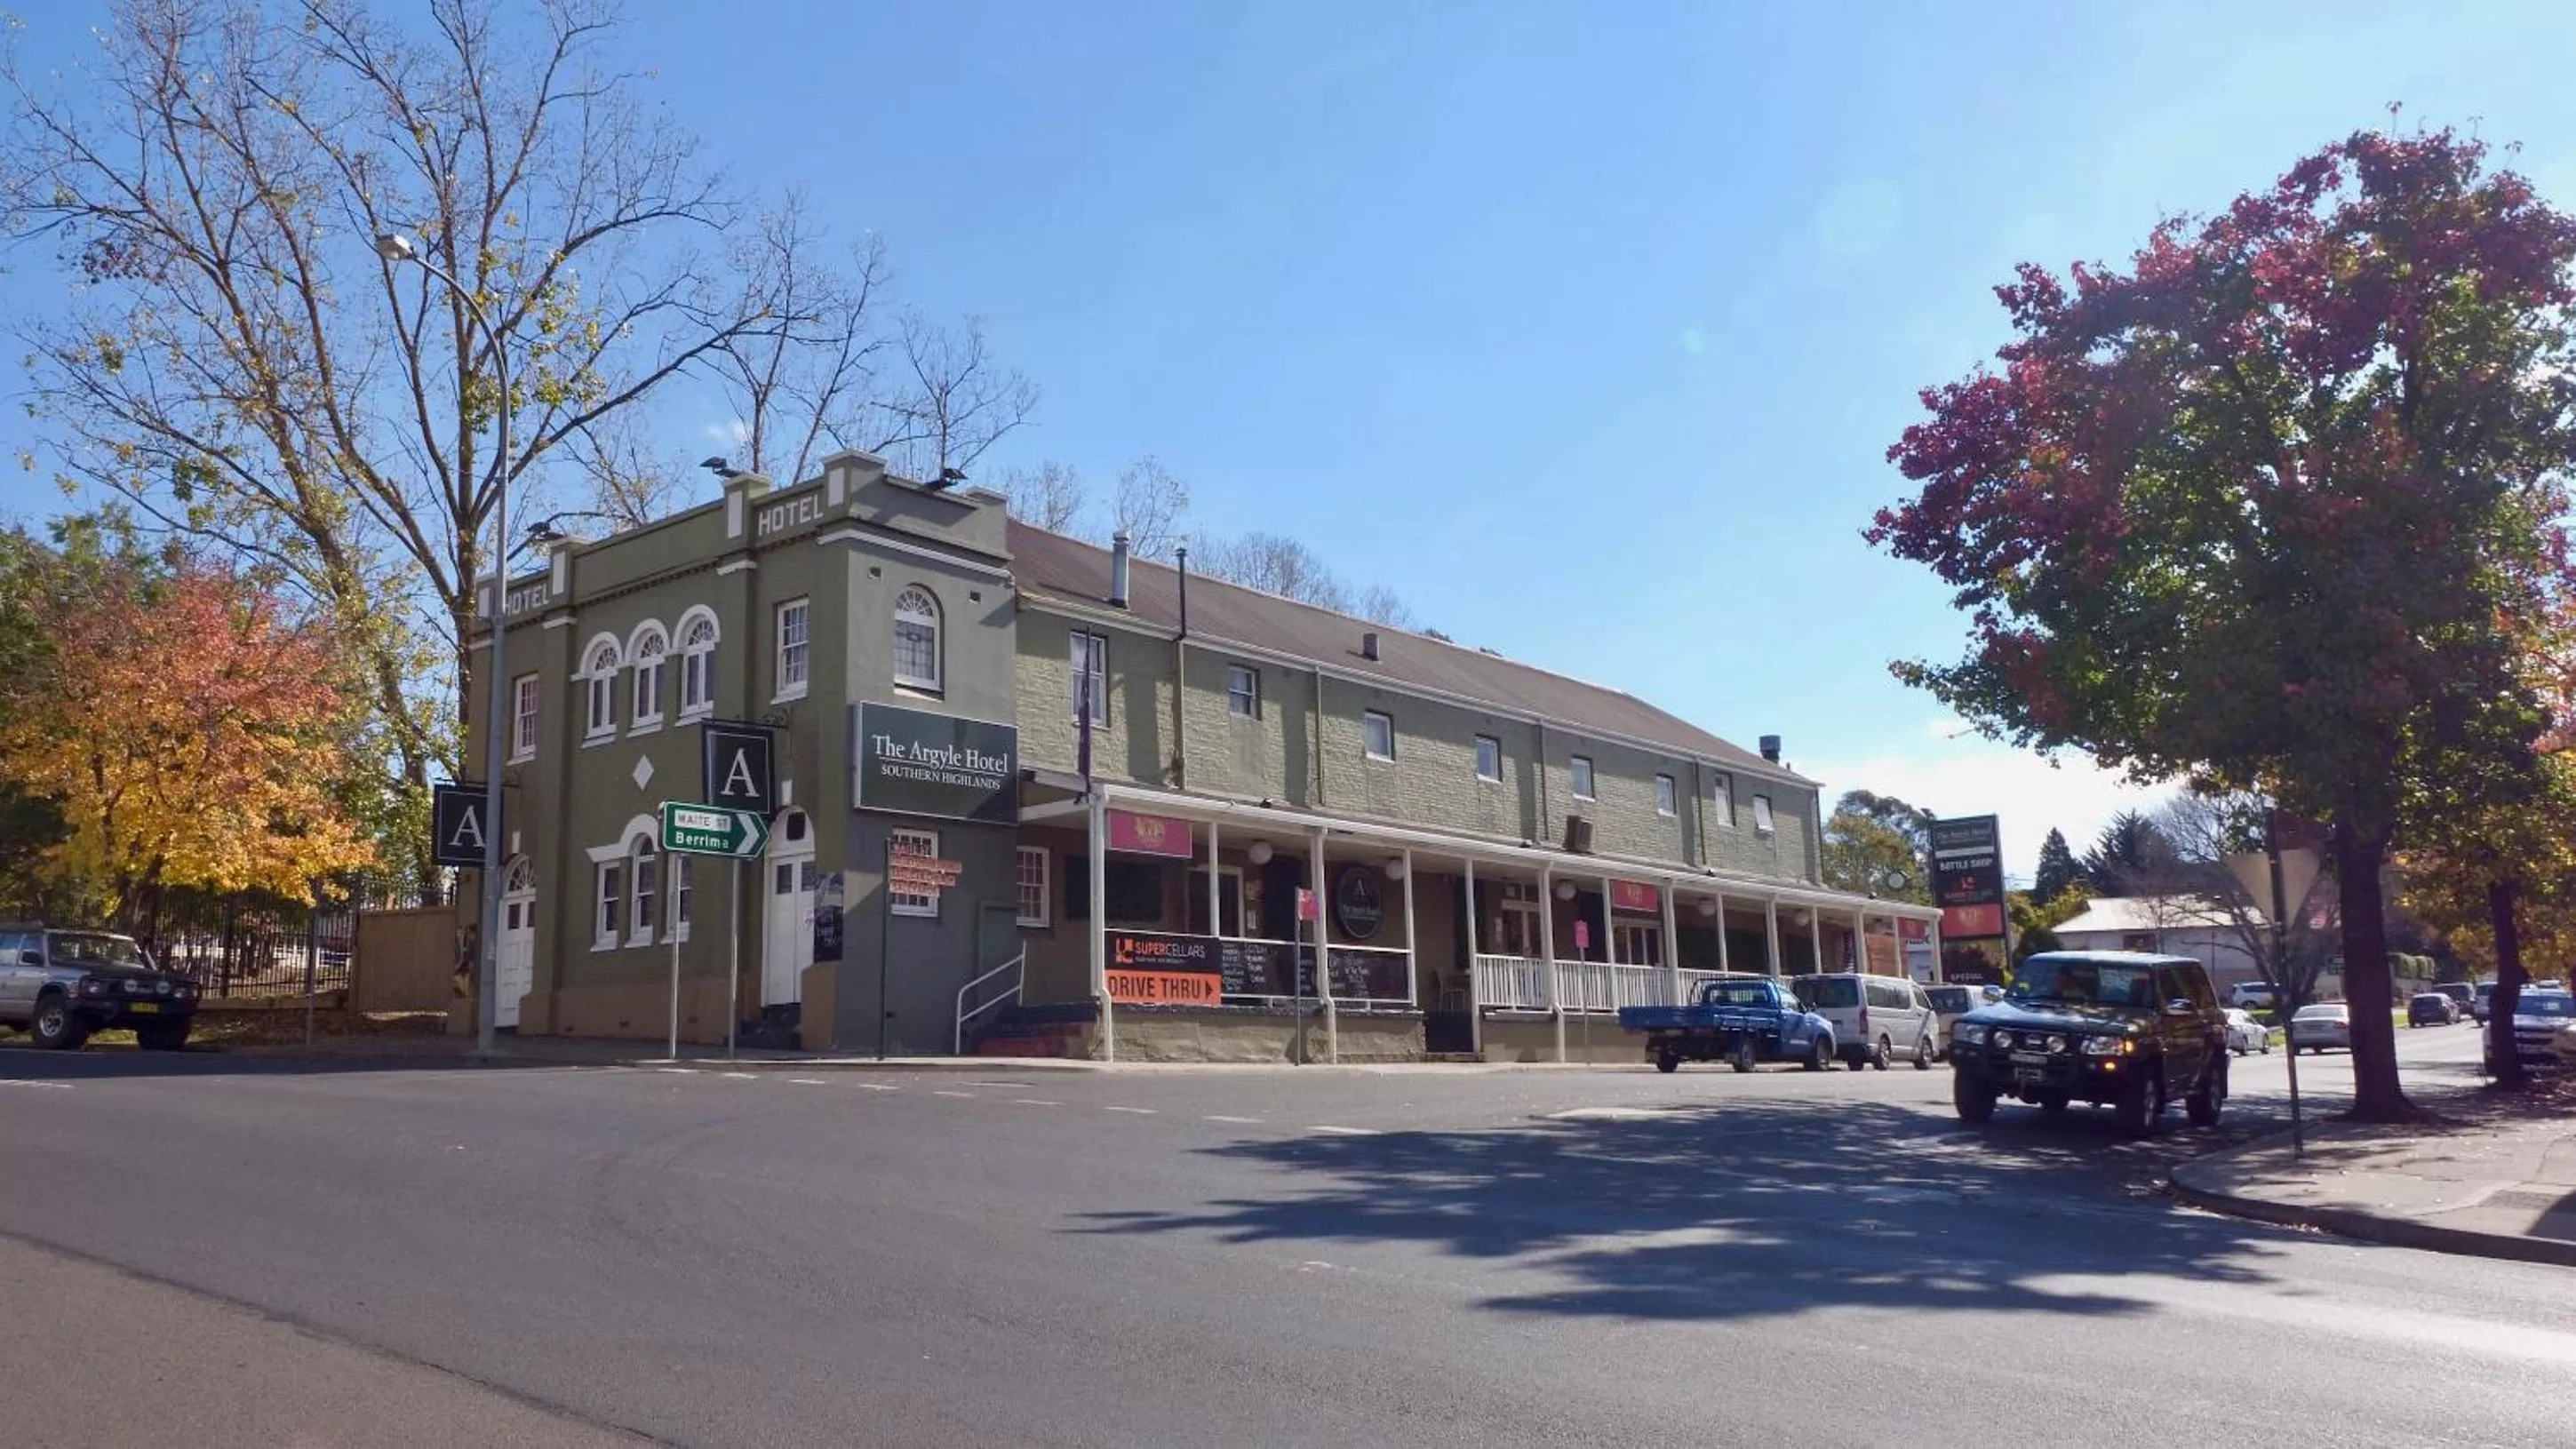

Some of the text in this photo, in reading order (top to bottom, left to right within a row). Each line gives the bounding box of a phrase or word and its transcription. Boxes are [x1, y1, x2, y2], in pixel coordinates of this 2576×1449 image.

[758, 493, 825, 537] HOTEL
[872, 734, 1009, 774] The Argyle Hotel
[721, 747, 761, 798] A
[881, 763, 1002, 791] SOUTHERN HIGHLANDS
[448, 805, 487, 848] A
[675, 831, 730, 849] Berrima
[1136, 942, 1207, 959] SUPERCELLARS
[1108, 975, 1201, 1000] DRIVE THRU
